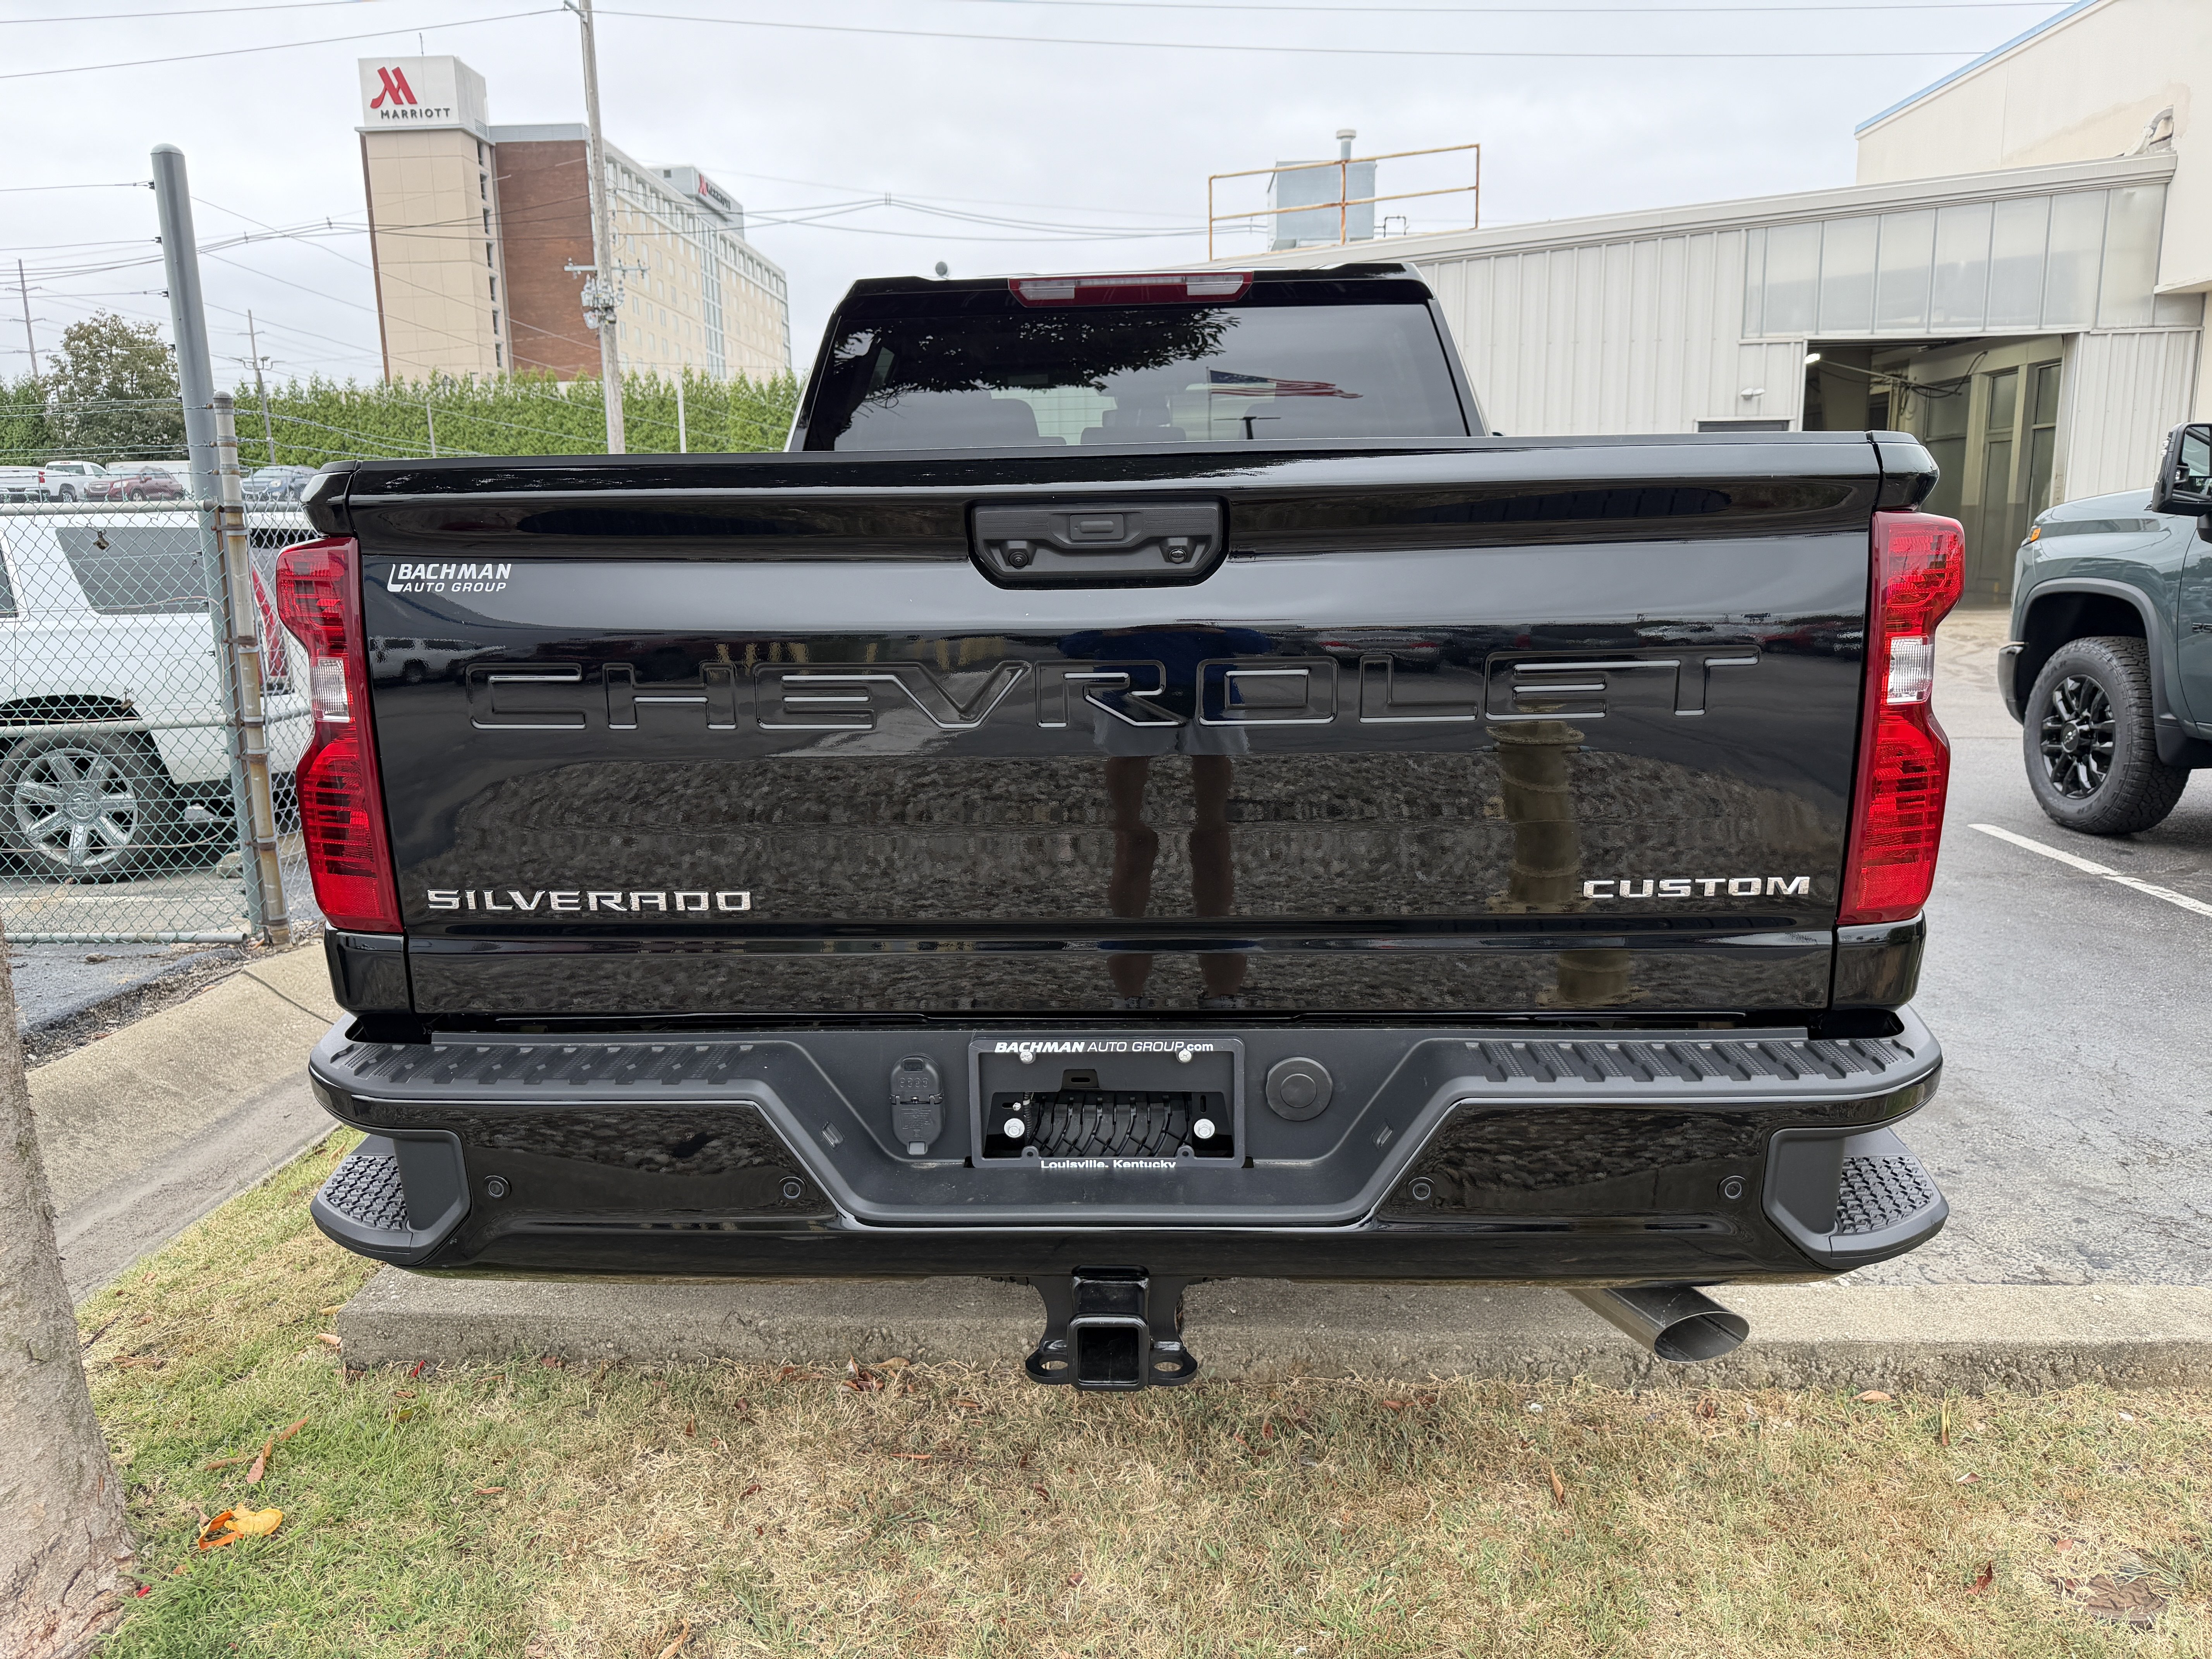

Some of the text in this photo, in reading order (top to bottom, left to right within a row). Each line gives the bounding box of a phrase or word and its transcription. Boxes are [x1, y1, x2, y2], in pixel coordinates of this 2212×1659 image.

[380, 108, 450, 119] MARRIOTT
[398, 563, 512, 579] BACHMAN
[402, 582, 507, 592] AUTO GROUP
[465, 644, 1761, 730] CHEVROLET
[1583, 876, 1810, 898] CUSTOM
[427, 889, 751, 911] SILVERADO
[994, 1042, 1085, 1053] BACHMAN
[1087, 1042, 1126, 1052] AUTO
[1113, 1159, 1176, 1168] Kentucky
